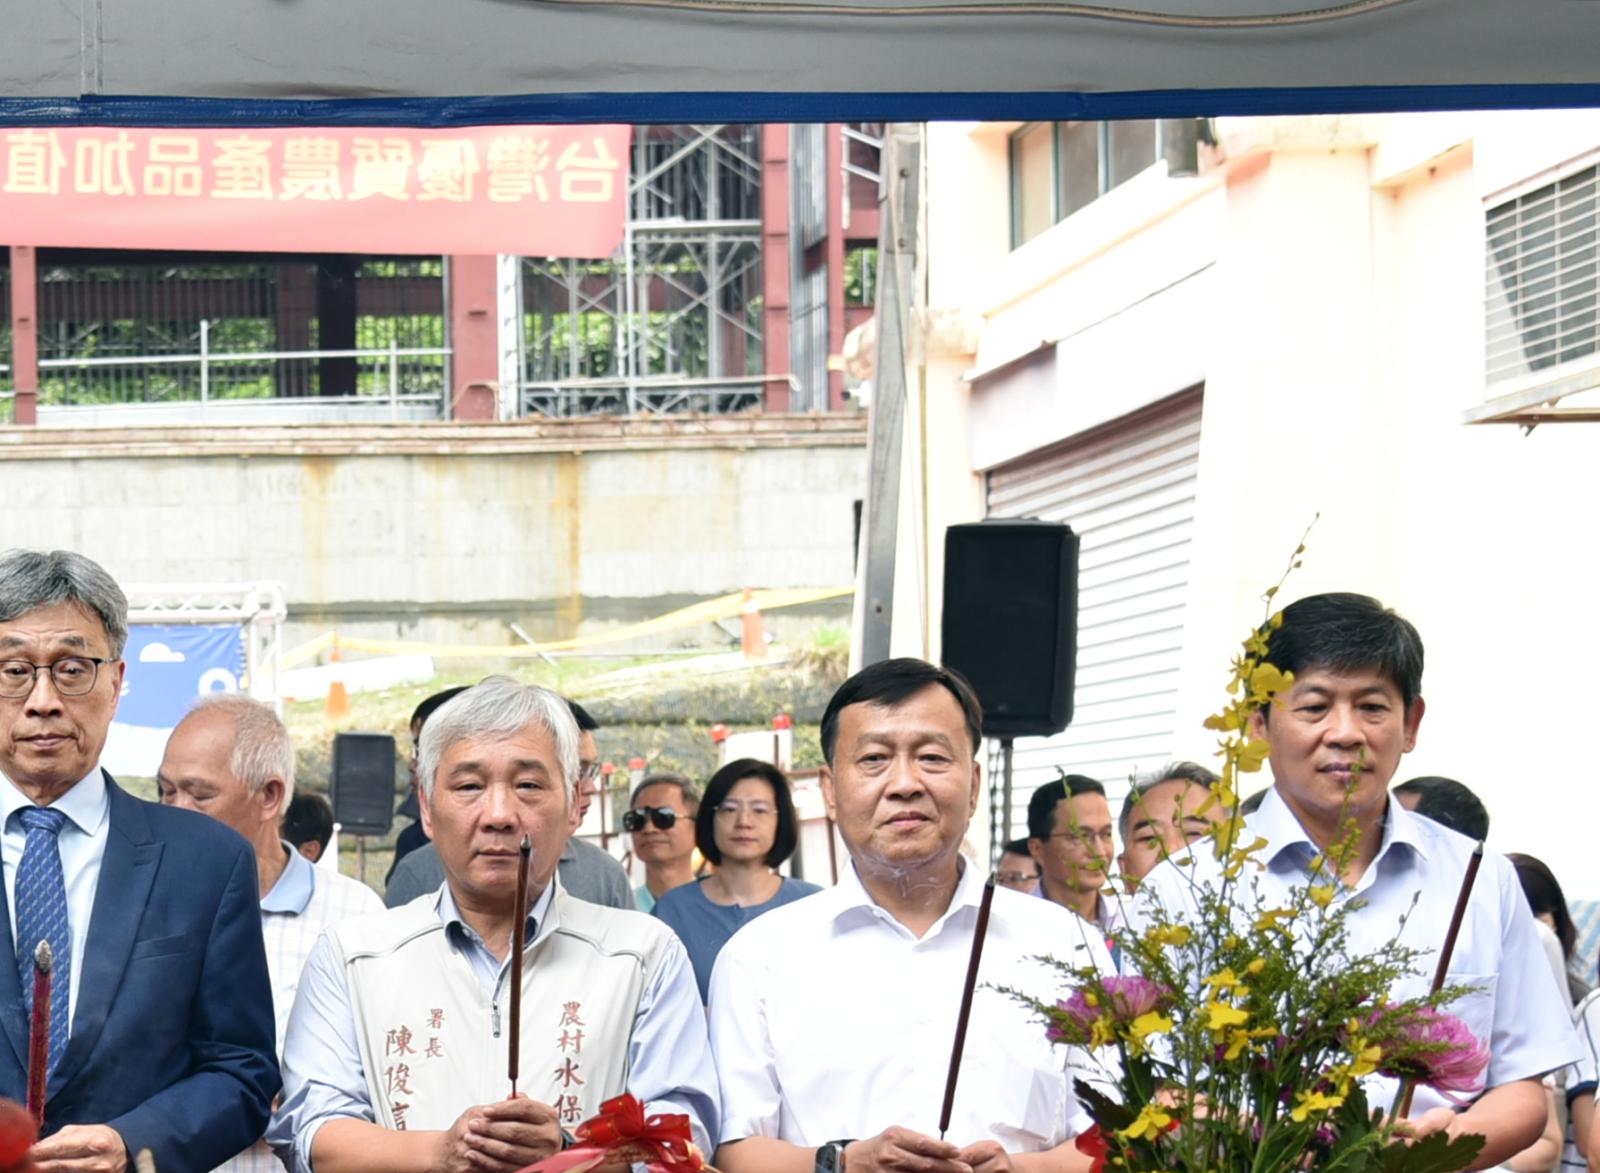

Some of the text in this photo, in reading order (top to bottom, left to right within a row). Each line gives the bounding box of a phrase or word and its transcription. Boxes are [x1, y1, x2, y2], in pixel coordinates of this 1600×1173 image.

[424, 1008, 445, 1059] 署長
[554, 1001, 586, 1123] 農村水保
